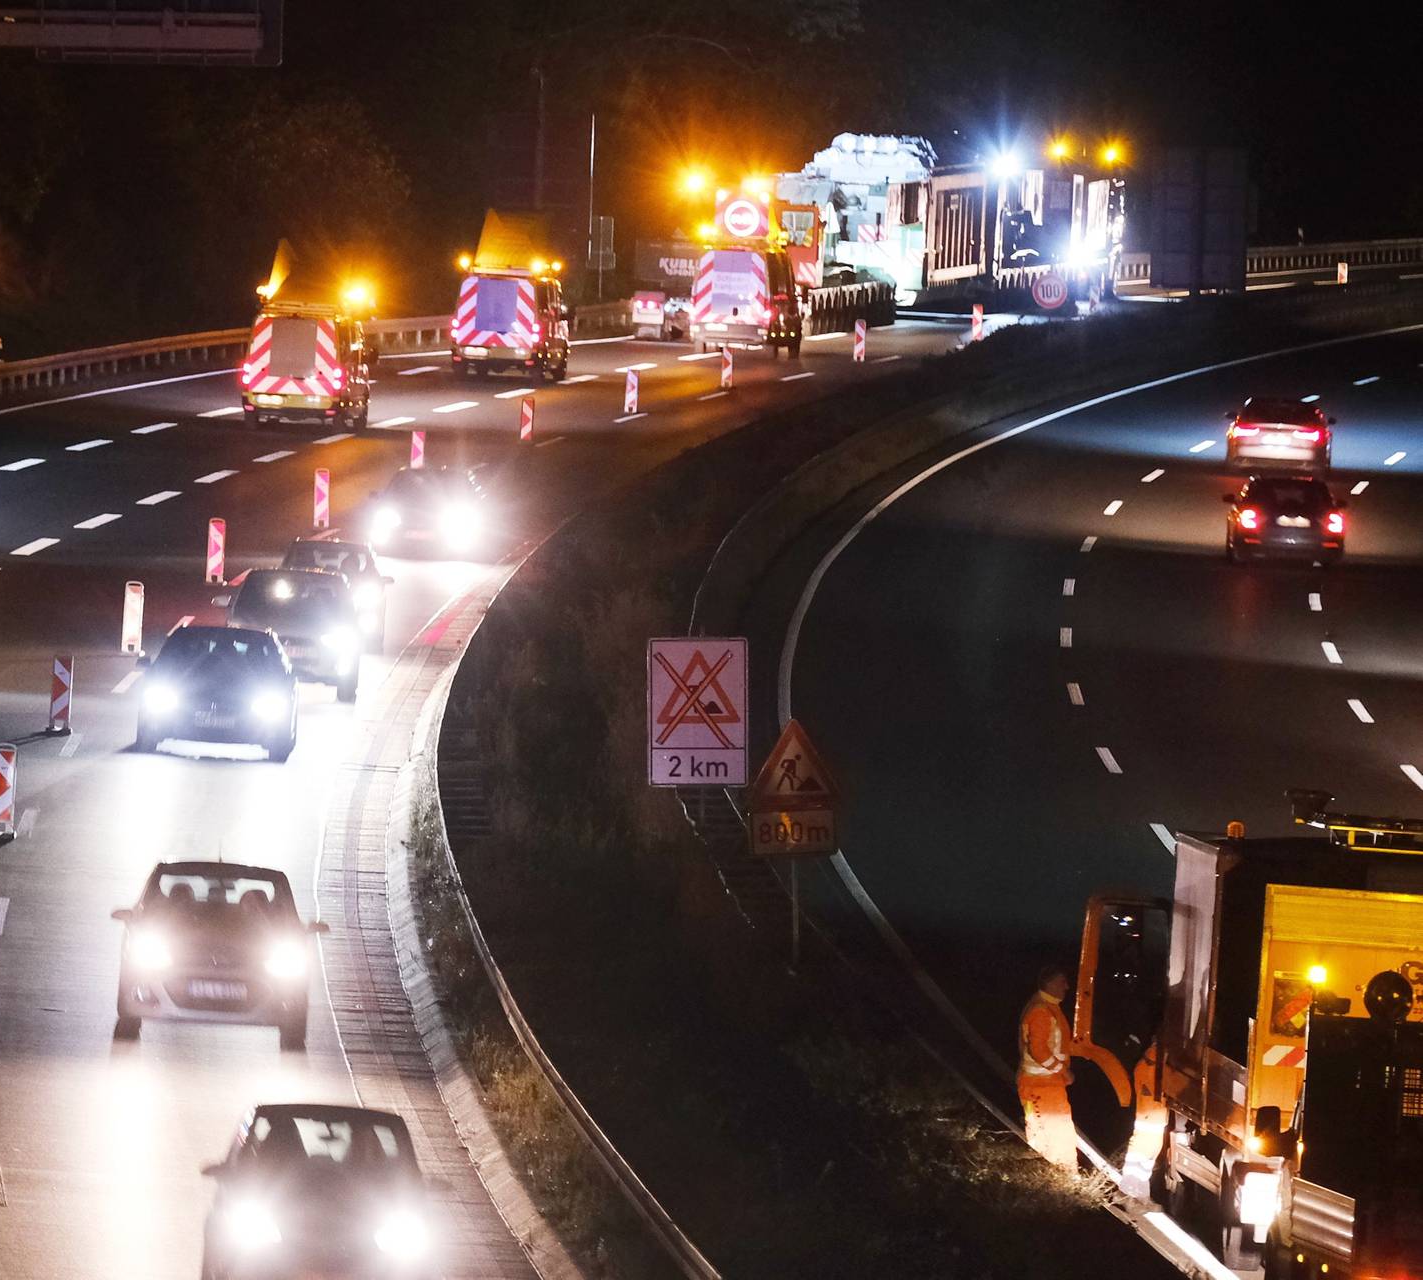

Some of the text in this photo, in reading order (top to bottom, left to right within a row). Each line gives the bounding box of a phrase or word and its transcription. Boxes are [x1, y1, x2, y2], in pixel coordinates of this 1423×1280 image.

[1040, 284, 1060, 298] 100
[668, 756, 729, 778] 2 km
